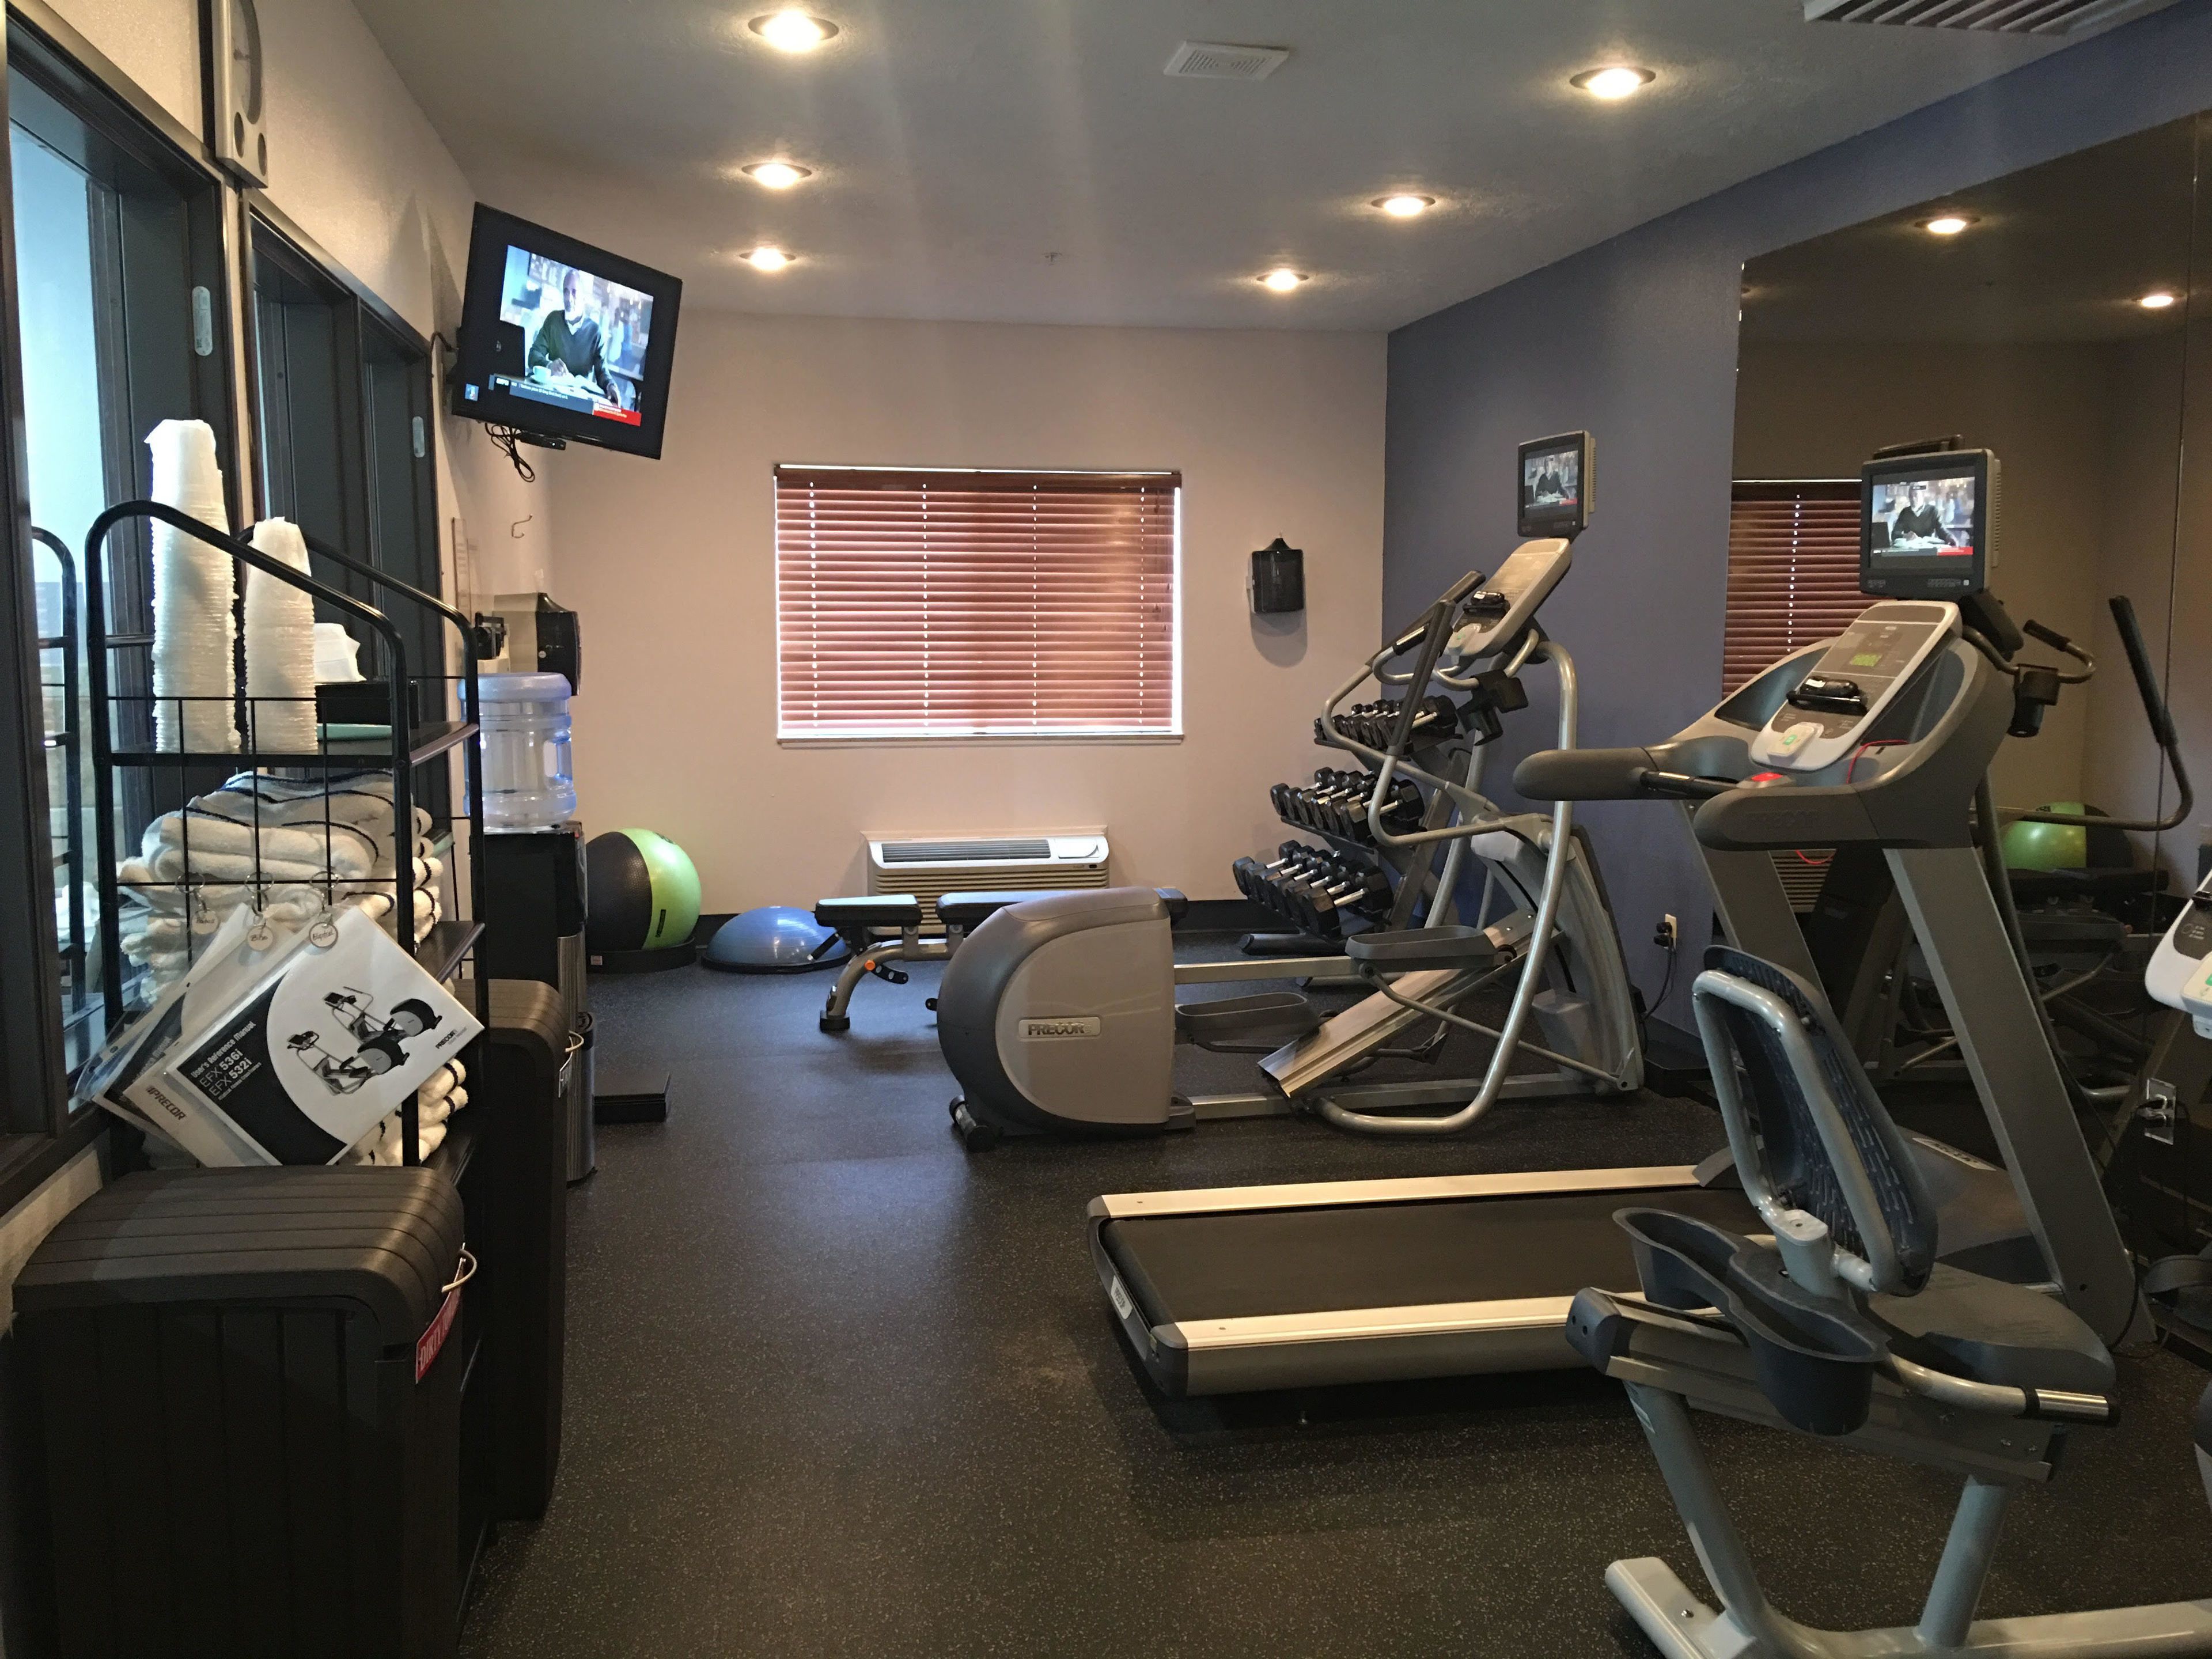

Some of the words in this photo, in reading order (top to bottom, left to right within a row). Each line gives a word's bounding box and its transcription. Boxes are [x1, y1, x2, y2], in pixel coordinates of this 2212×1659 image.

[1028, 1022, 1085, 1035] PRECOR
[190, 1062, 210, 1078] User's
[207, 1039, 236, 1064] Reference
[233, 1021, 256, 1041] Manual
[199, 1066, 222, 1088] EFX
[219, 1048, 243, 1070] 536i
[209, 1075, 232, 1096] EFX
[229, 1057, 252, 1079] 532i
[149, 1087, 187, 1120] PRECOR
